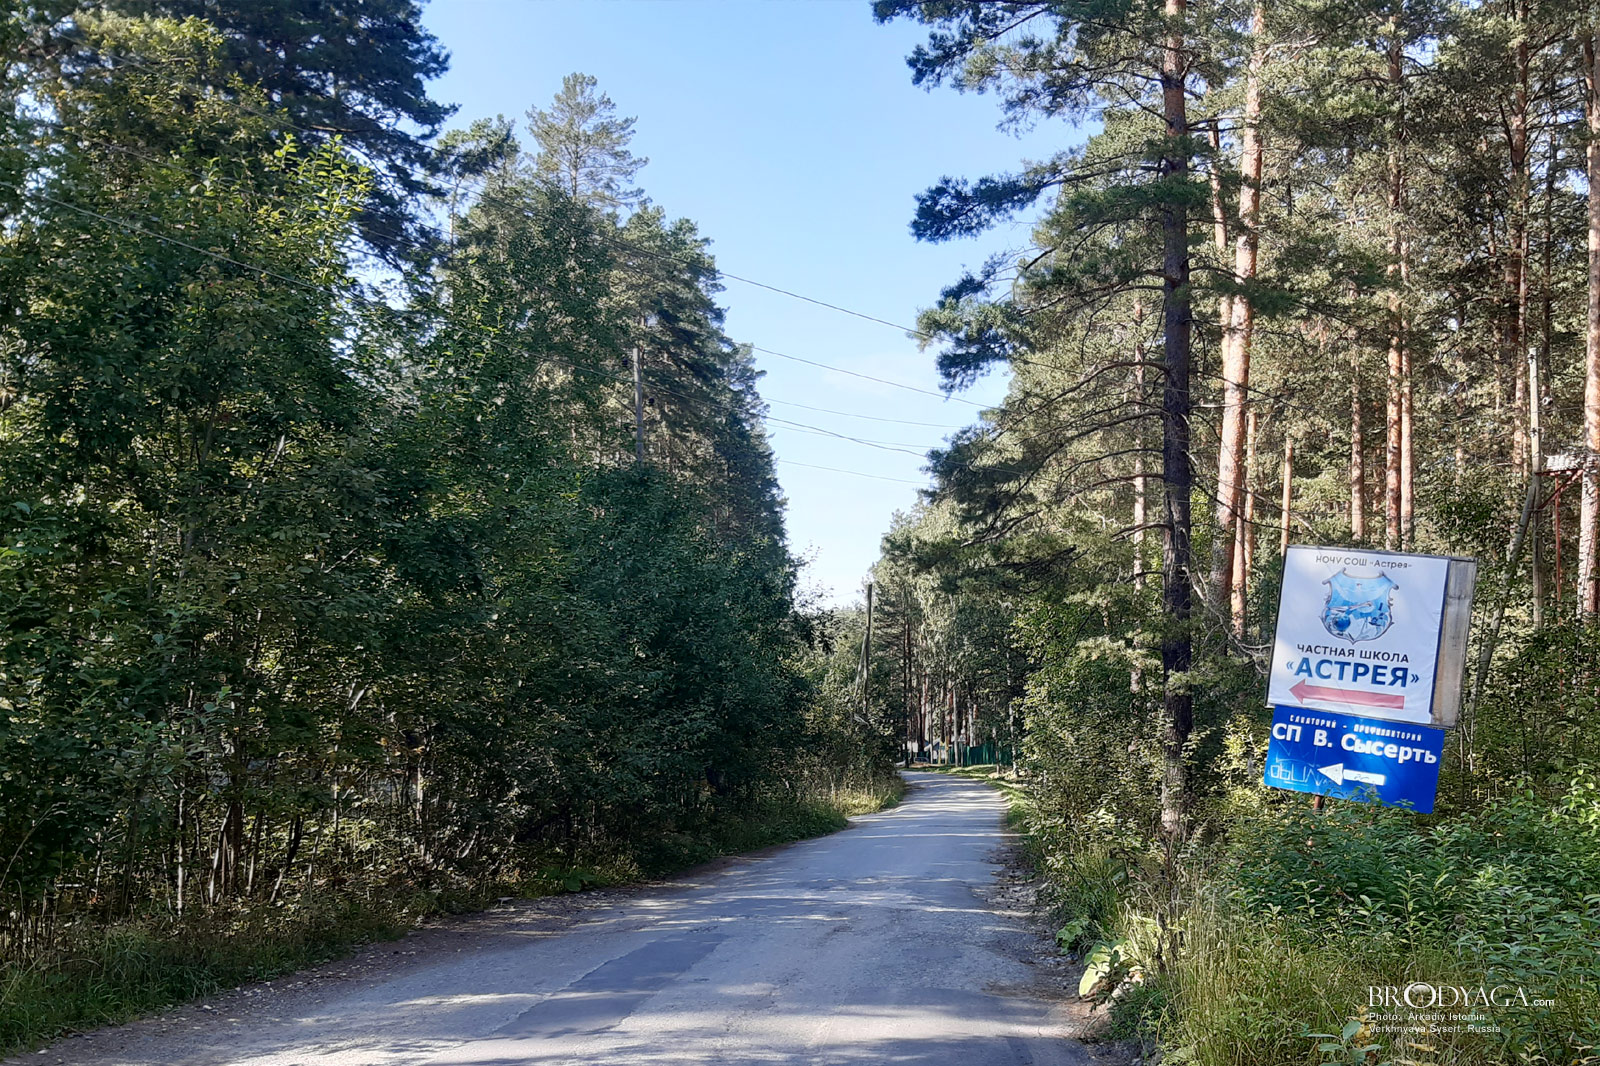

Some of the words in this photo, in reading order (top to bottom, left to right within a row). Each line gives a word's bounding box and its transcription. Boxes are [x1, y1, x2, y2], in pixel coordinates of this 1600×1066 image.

[1316, 555, 1342, 564] НОЧУ
[1344, 557, 1367, 566] СОШ
[1297, 643, 1355, 658] ЧАСТНАЯ
[1360, 649, 1409, 663] ШКОЛА
[1286, 657, 1420, 688] «АСТРЕЯ»
[1290, 714, 1337, 729] САНАТОРИЙ
[1272, 722, 1302, 742] СП
[1313, 729, 1333, 748] В.
[1341, 733, 1437, 764] Сысерть
